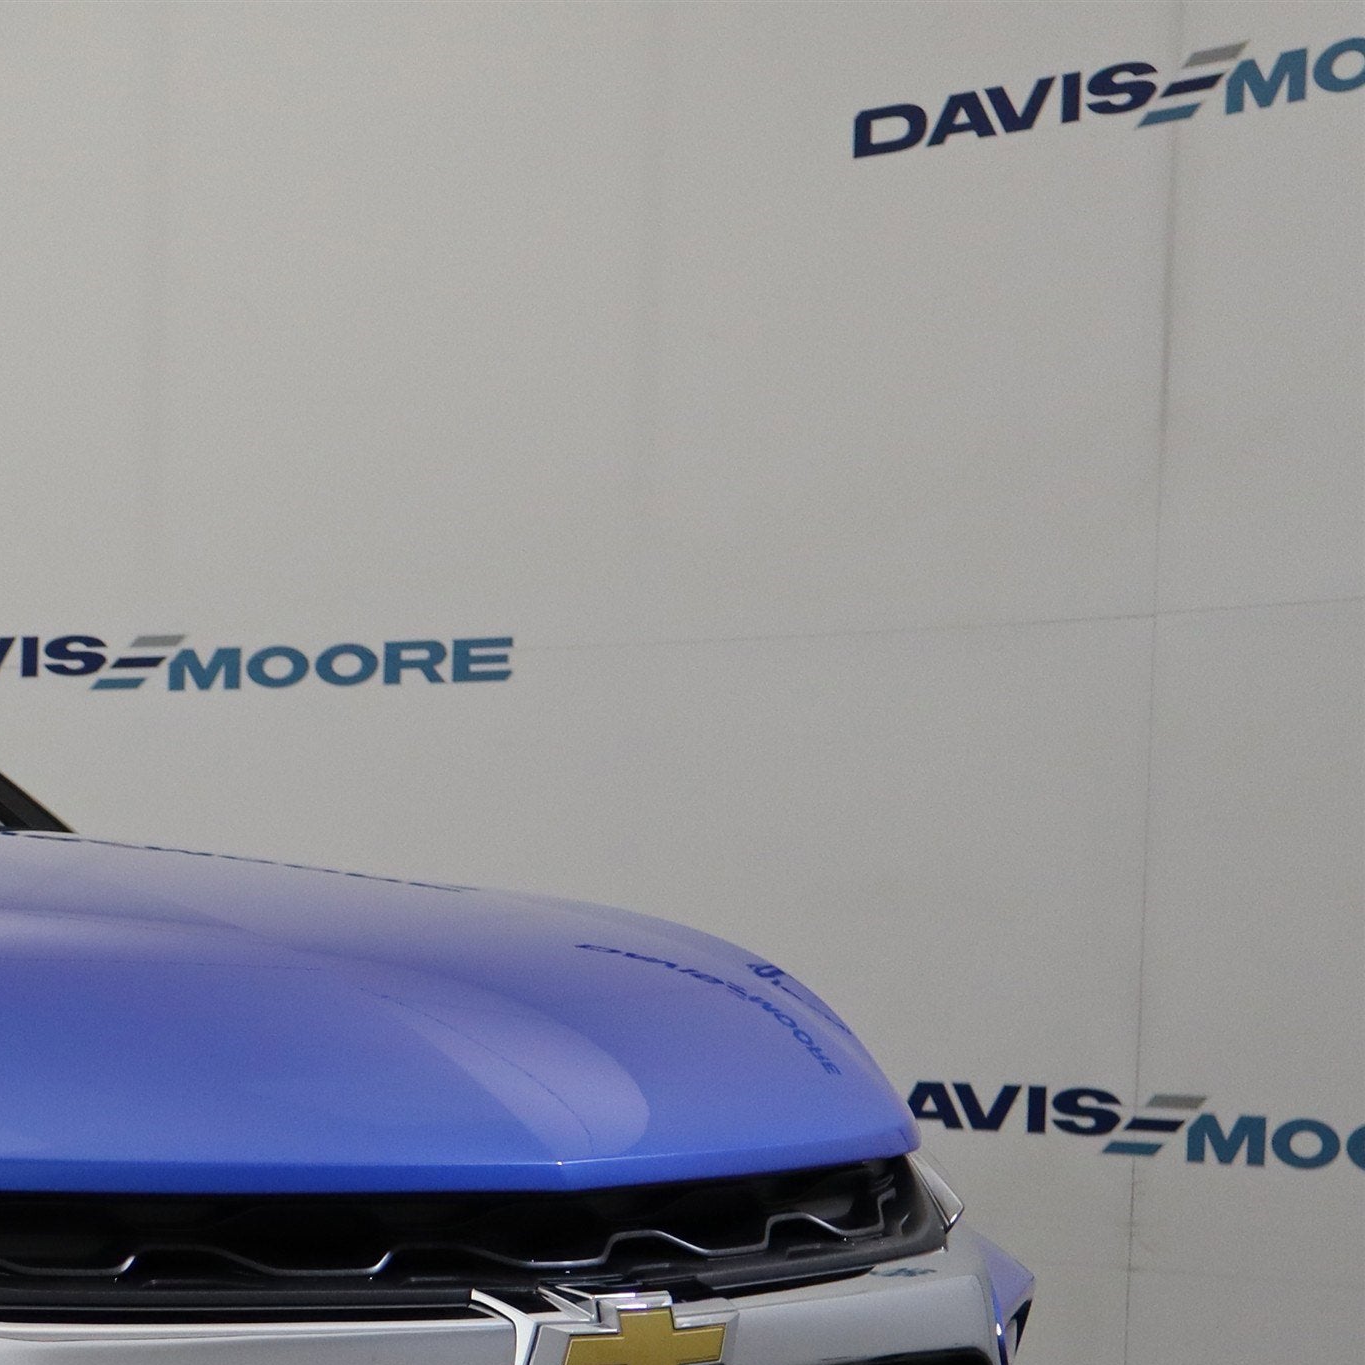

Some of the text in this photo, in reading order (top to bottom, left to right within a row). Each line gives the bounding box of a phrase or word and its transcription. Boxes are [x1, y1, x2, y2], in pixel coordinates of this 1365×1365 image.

[853, 61, 1159, 159] DAVIS
[169, 637, 514, 692] MOORE
[907, 1080, 1365, 1170] AVIS MO
